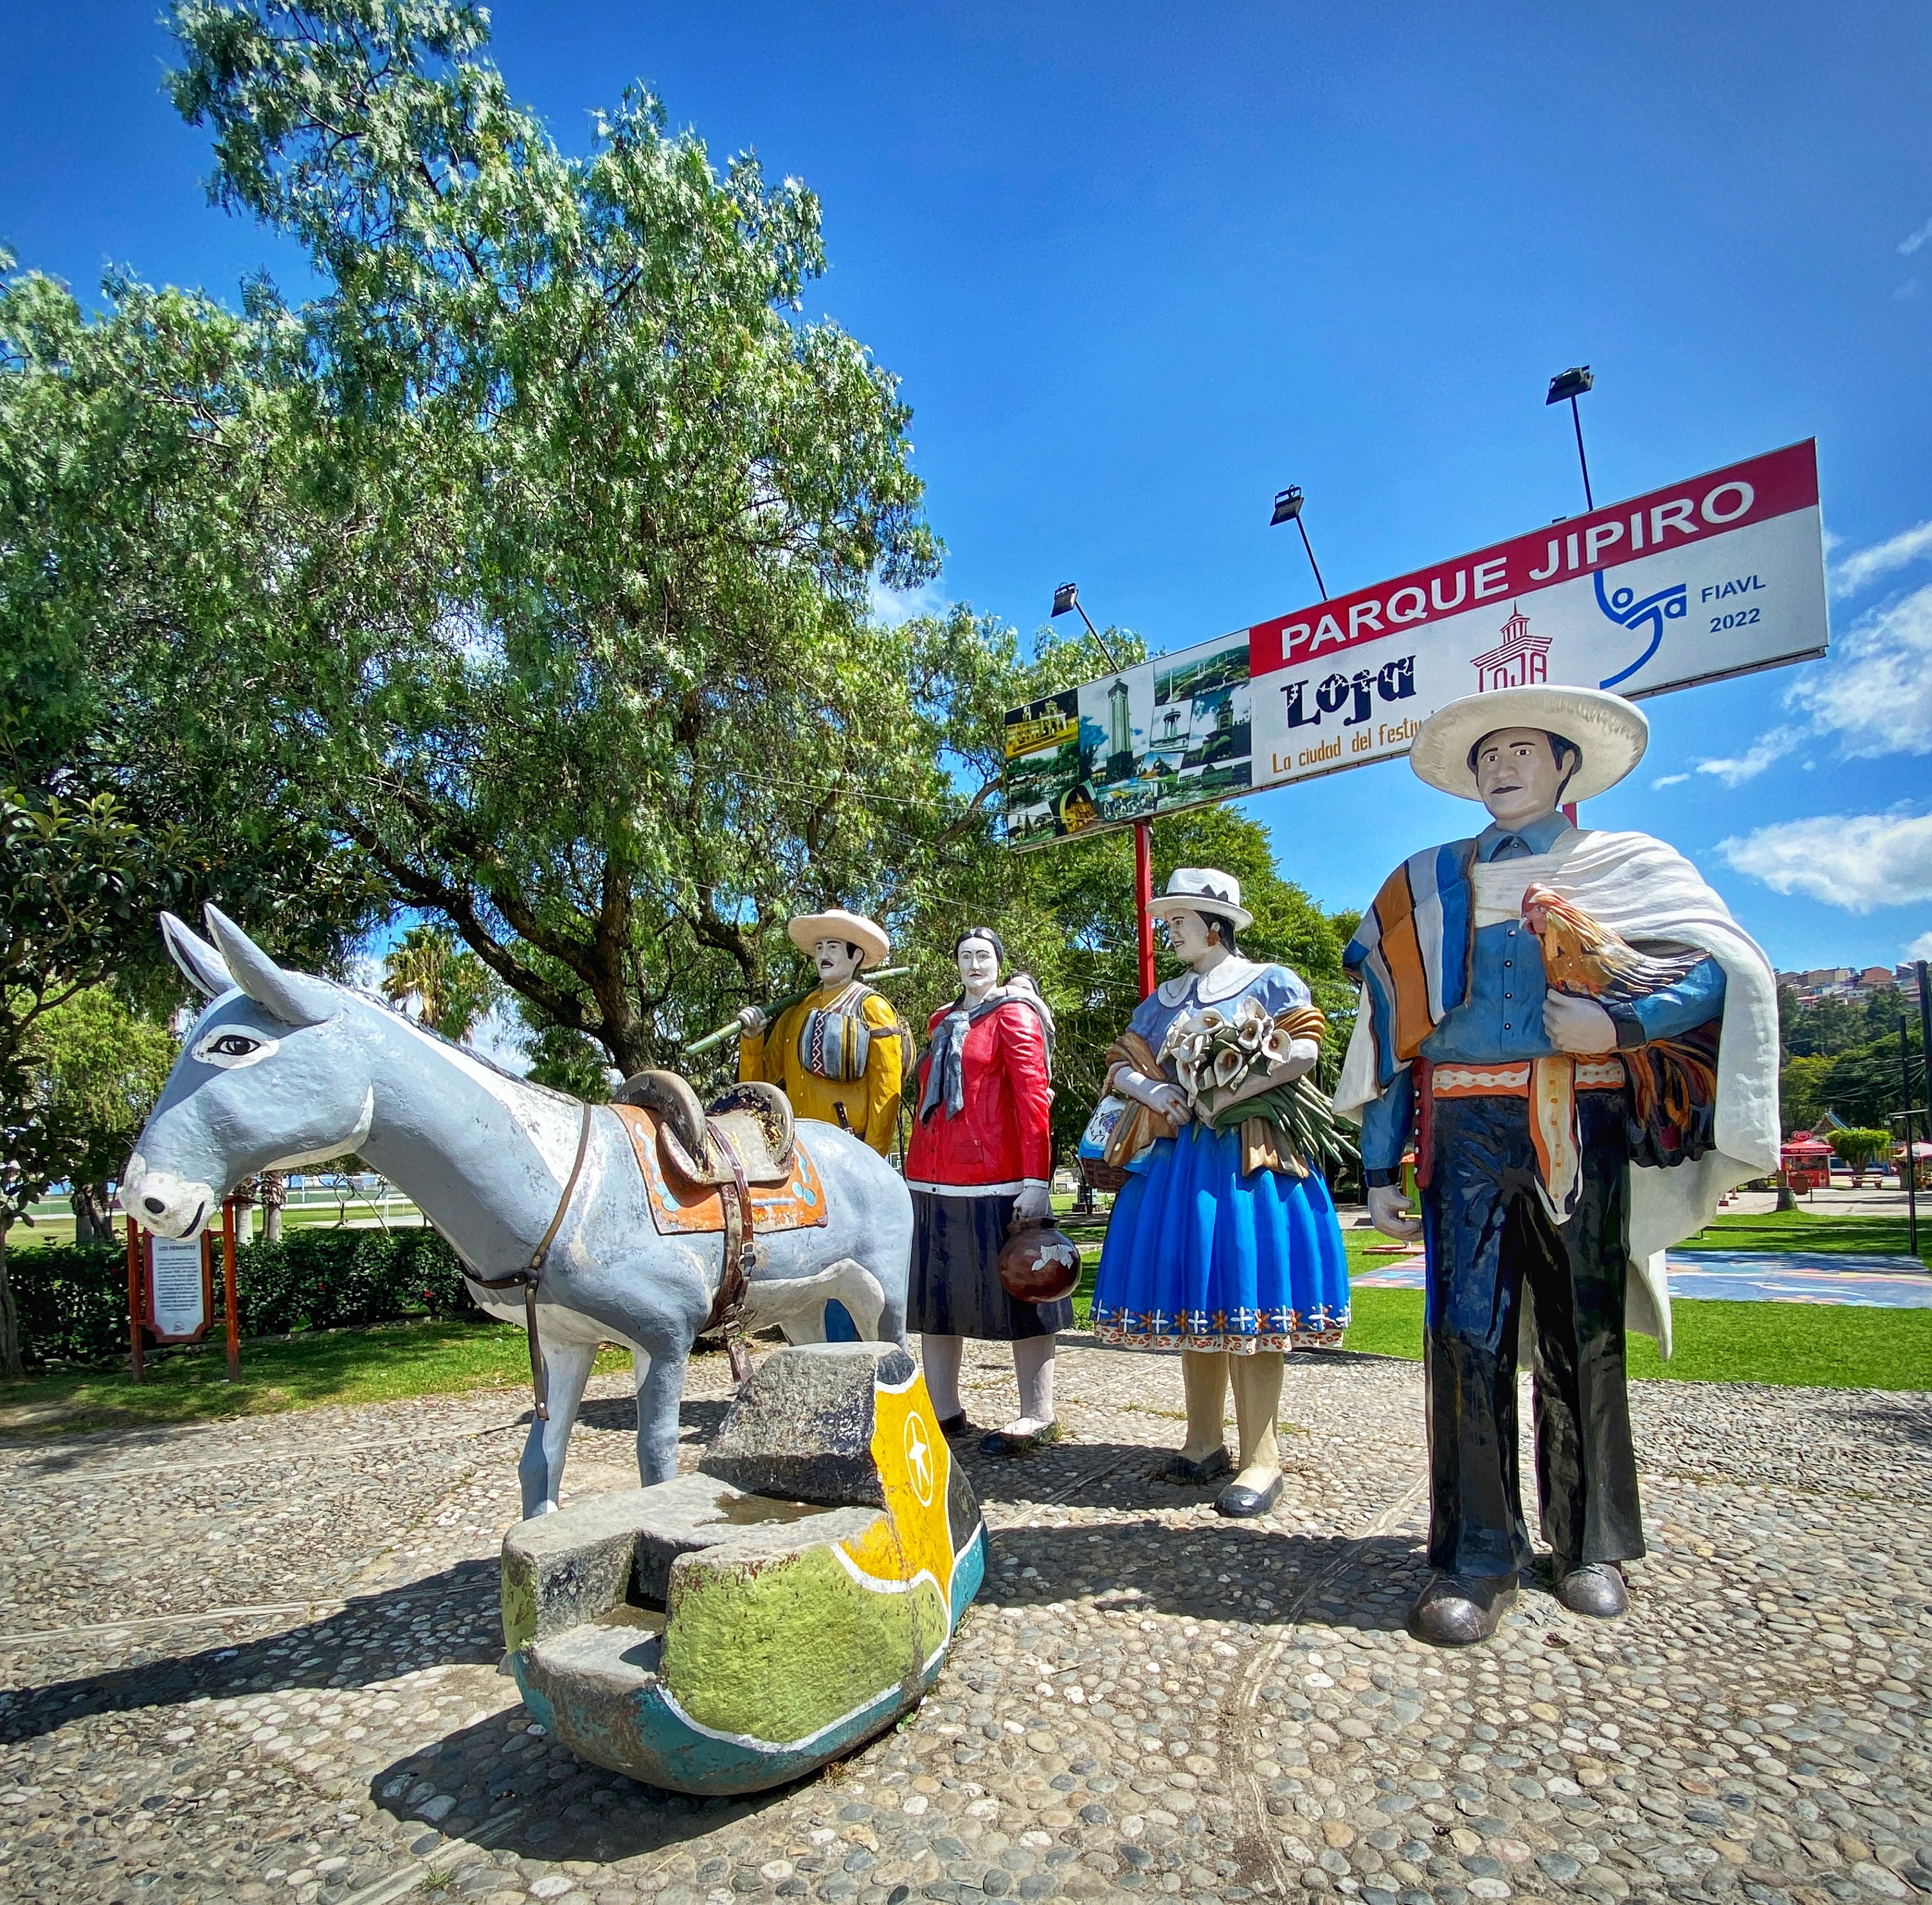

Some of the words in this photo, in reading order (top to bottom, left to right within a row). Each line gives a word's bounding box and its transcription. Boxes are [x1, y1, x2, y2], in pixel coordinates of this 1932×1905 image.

[1281, 557, 1509, 660] PARQUE
[1528, 481, 1755, 581] JIPIRO
[1701, 574, 1766, 604] FIAVL
[1709, 608, 1761, 633] 2022
[1280, 655, 1417, 729] Loja
[1272, 753, 1292, 774] La
[1299, 735, 1342, 767] ciudad
[1351, 727, 1373, 754] del
[1378, 710, 1434, 746] festiv
